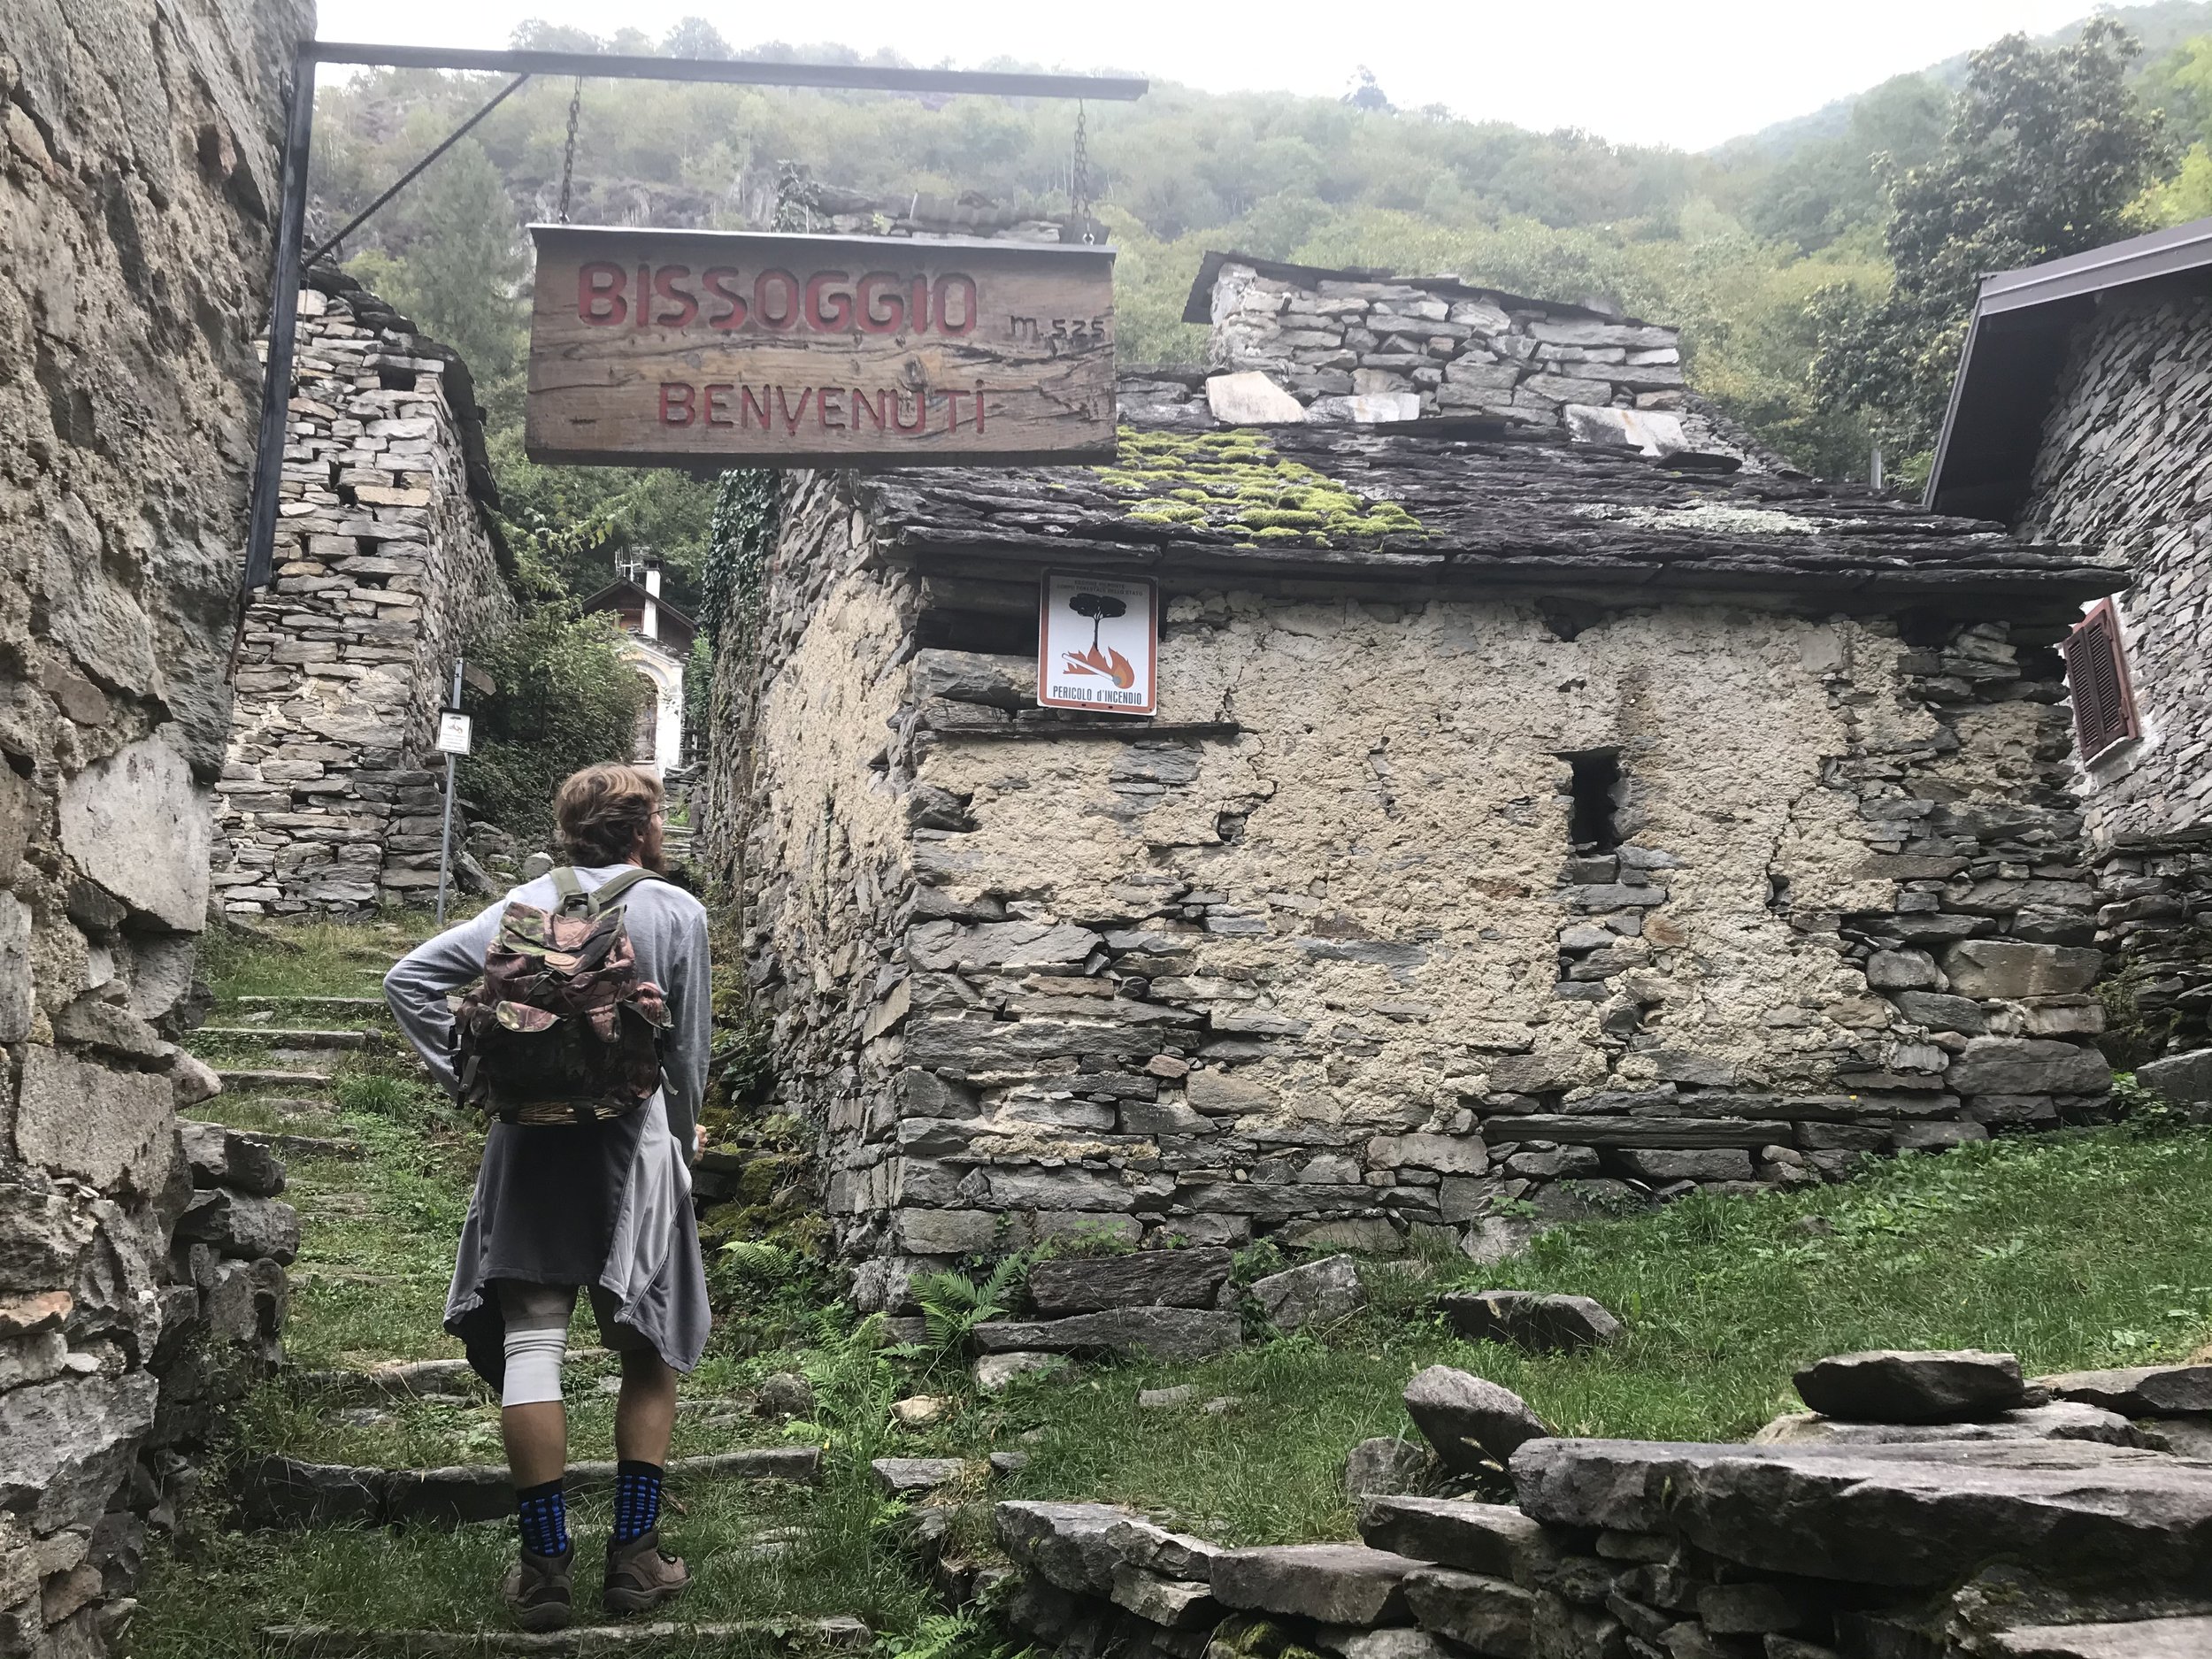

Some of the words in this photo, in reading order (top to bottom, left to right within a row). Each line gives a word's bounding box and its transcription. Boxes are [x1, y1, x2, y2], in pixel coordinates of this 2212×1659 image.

[578, 255, 978, 337] BISSOGGIO
[1053, 685, 1092, 702] PERICOLO
[1097, 689, 1142, 705] d'INCENDIO
